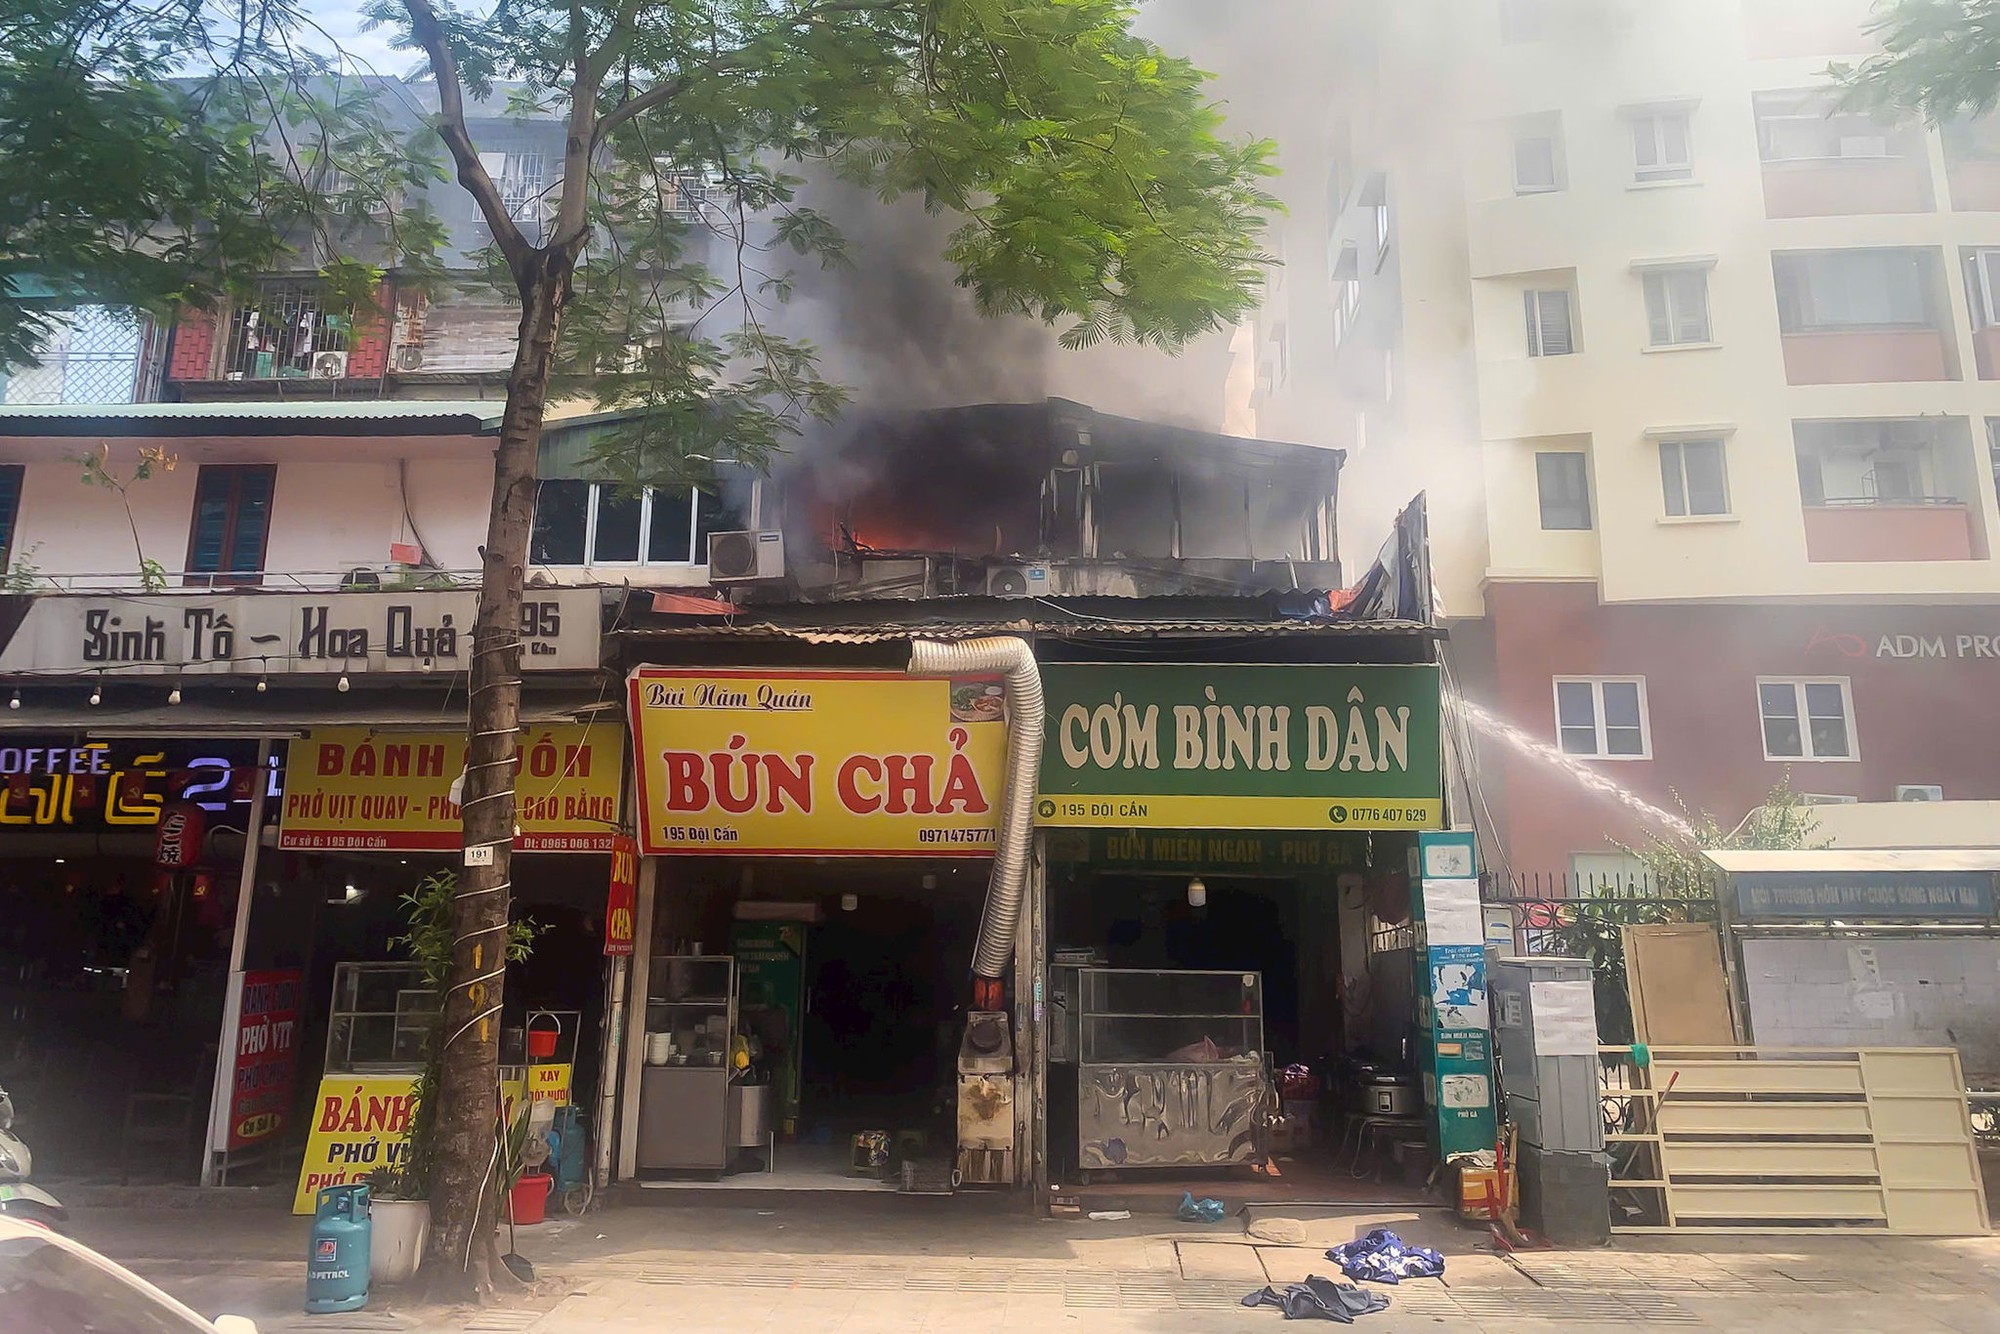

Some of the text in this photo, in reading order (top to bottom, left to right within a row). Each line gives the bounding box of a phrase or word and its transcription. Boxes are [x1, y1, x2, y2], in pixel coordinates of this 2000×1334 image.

[520, 602, 559, 636] 95
[83, 609, 165, 661] Sinh
[299, 606, 368, 659] Hoa
[386, 605, 457, 658] Quả
[1875, 633, 1947, 658] ADM
[645, 683, 812, 712] Bùi Năm Quán
[1059, 685, 1411, 772] CƠM BÌNH DÂN
[0, 748, 111, 774] OFFEE
[316, 737, 445, 777] BÁNH
[662, 727, 989, 814] BÚN CHẢ
[287, 787, 324, 819] PHỞ
[328, 795, 357, 824] VỊT
[361, 796, 409, 820] QUAY
[1061, 804, 1085, 816] 195
[1352, 808, 1427, 822] 0776 407 629
[326, 836, 345, 848] 195
[541, 838, 567, 849] 0965
[662, 826, 685, 841] 195
[919, 828, 997, 843] 0971475771
[471, 850, 487, 859] 191
[539, 1070, 561, 1082] XAY
[318, 1085, 415, 1133] BÁNH
[327, 1136, 381, 1164] PHỞ
